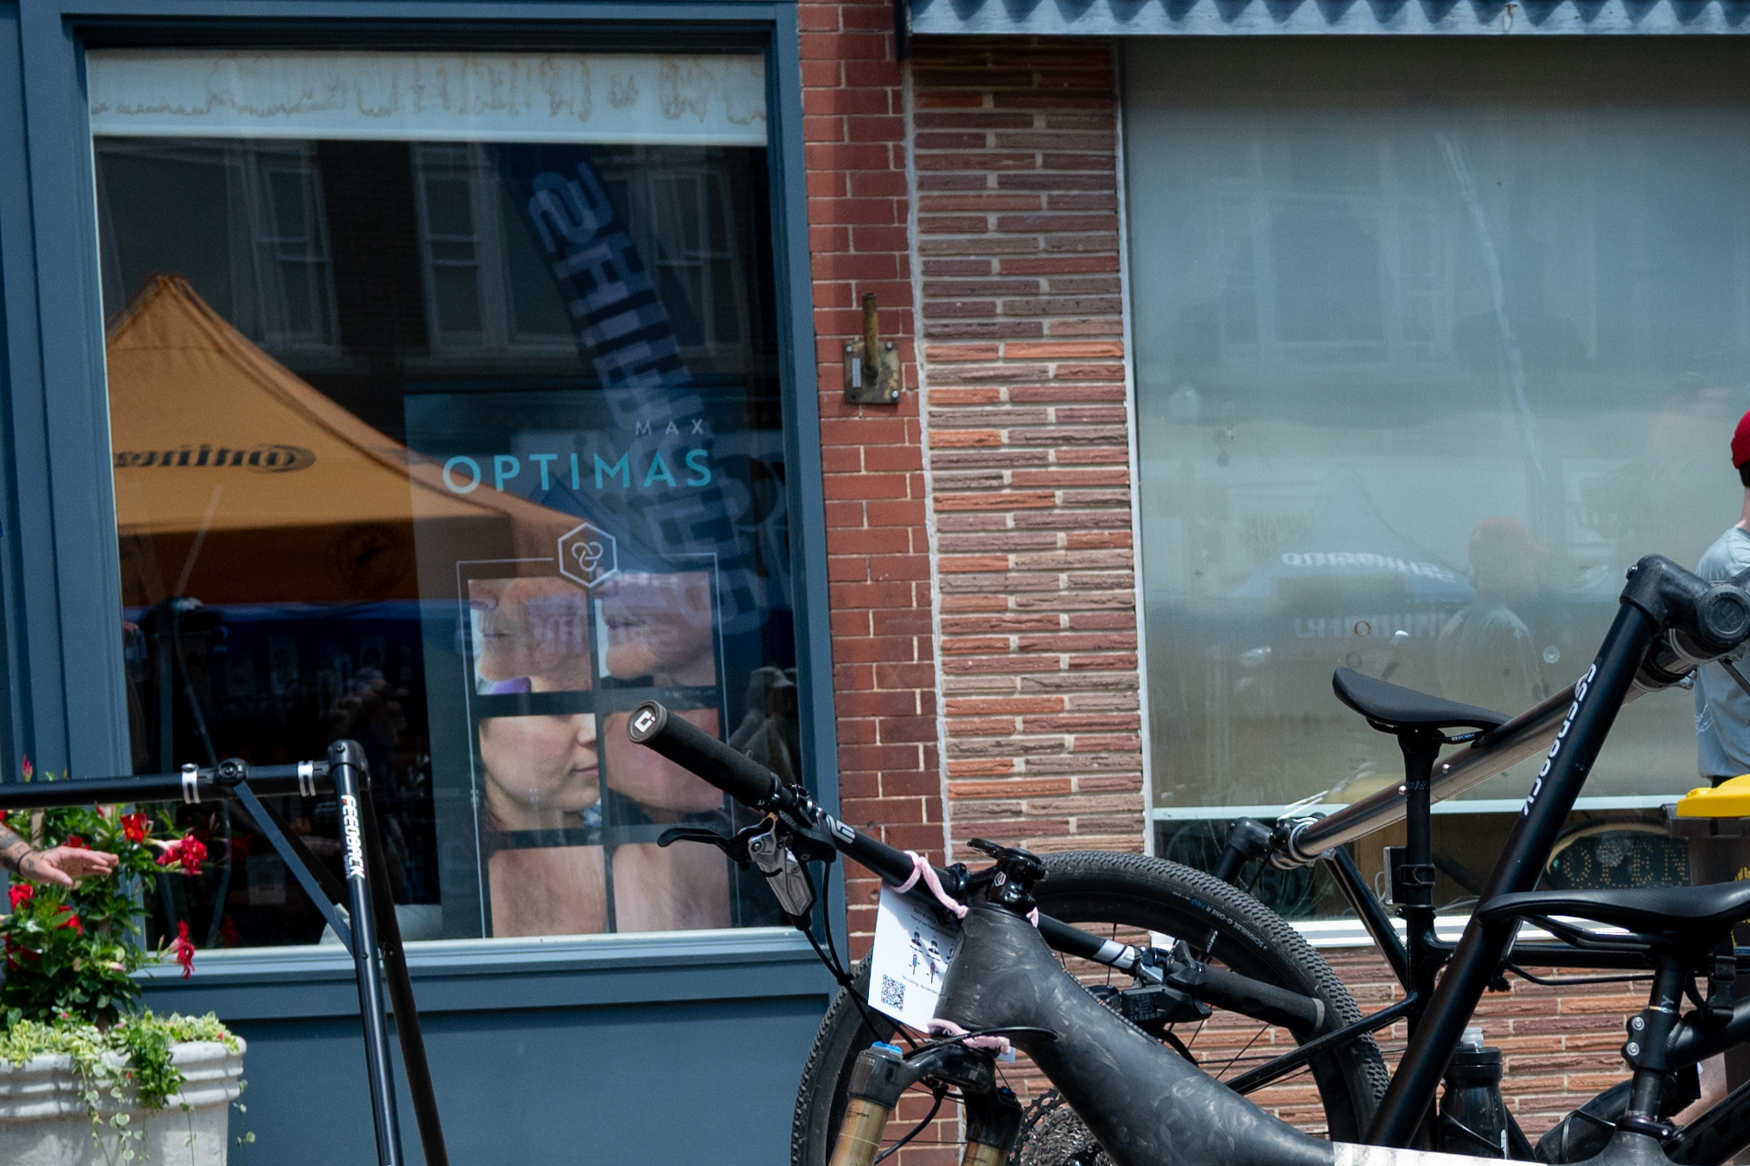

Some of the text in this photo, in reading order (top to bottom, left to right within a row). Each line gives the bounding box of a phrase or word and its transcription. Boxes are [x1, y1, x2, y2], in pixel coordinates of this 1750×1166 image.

[635, 418, 705, 437] MAX
[442, 448, 712, 494] OPTIMAS
[341, 794, 366, 879] FEEDBACK
[1563, 844, 1690, 884] OPEN
